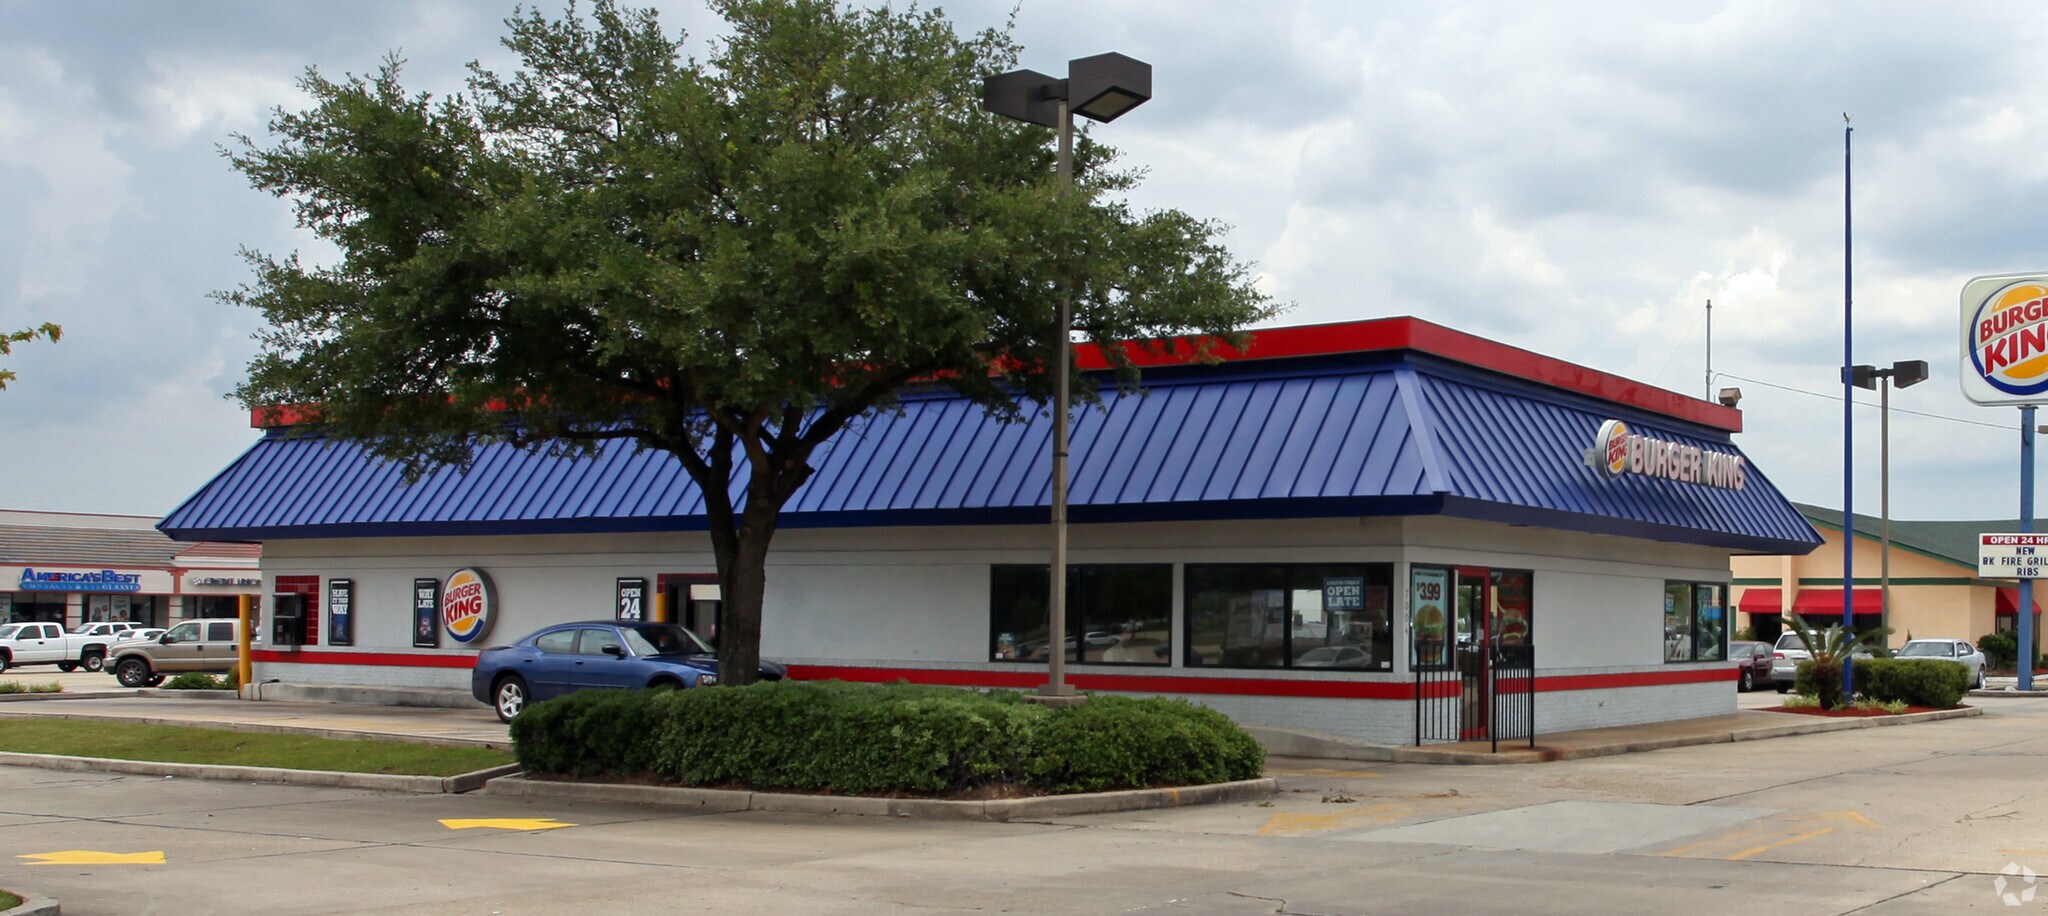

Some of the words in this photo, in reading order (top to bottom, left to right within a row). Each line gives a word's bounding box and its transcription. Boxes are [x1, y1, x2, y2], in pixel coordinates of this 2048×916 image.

[1984, 322, 2048, 375] KIN
[1607, 443, 1628, 465] KING
[1631, 434, 1700, 484] BURGER
[1708, 451, 1745, 490] KING
[1990, 536, 2018, 544] OPEN
[2021, 536, 2033, 544] 24
[2016, 547, 2035, 555] NEW
[1983, 557, 1995, 565] BK
[2001, 557, 2022, 566] FIRE
[21, 568, 101, 582] AMERICA'S
[102, 570, 141, 583] BEST
[2017, 568, 2039, 576] RIBS
[418, 588, 435, 599] WAY
[445, 583, 482, 606] BURGER
[621, 588, 641, 597] OPEN
[1327, 586, 1360, 595] OPEN
[418, 600, 434, 608] LATE
[1327, 597, 1360, 607] LATE
[446, 595, 482, 625] KING
[621, 598, 640, 619] 24
